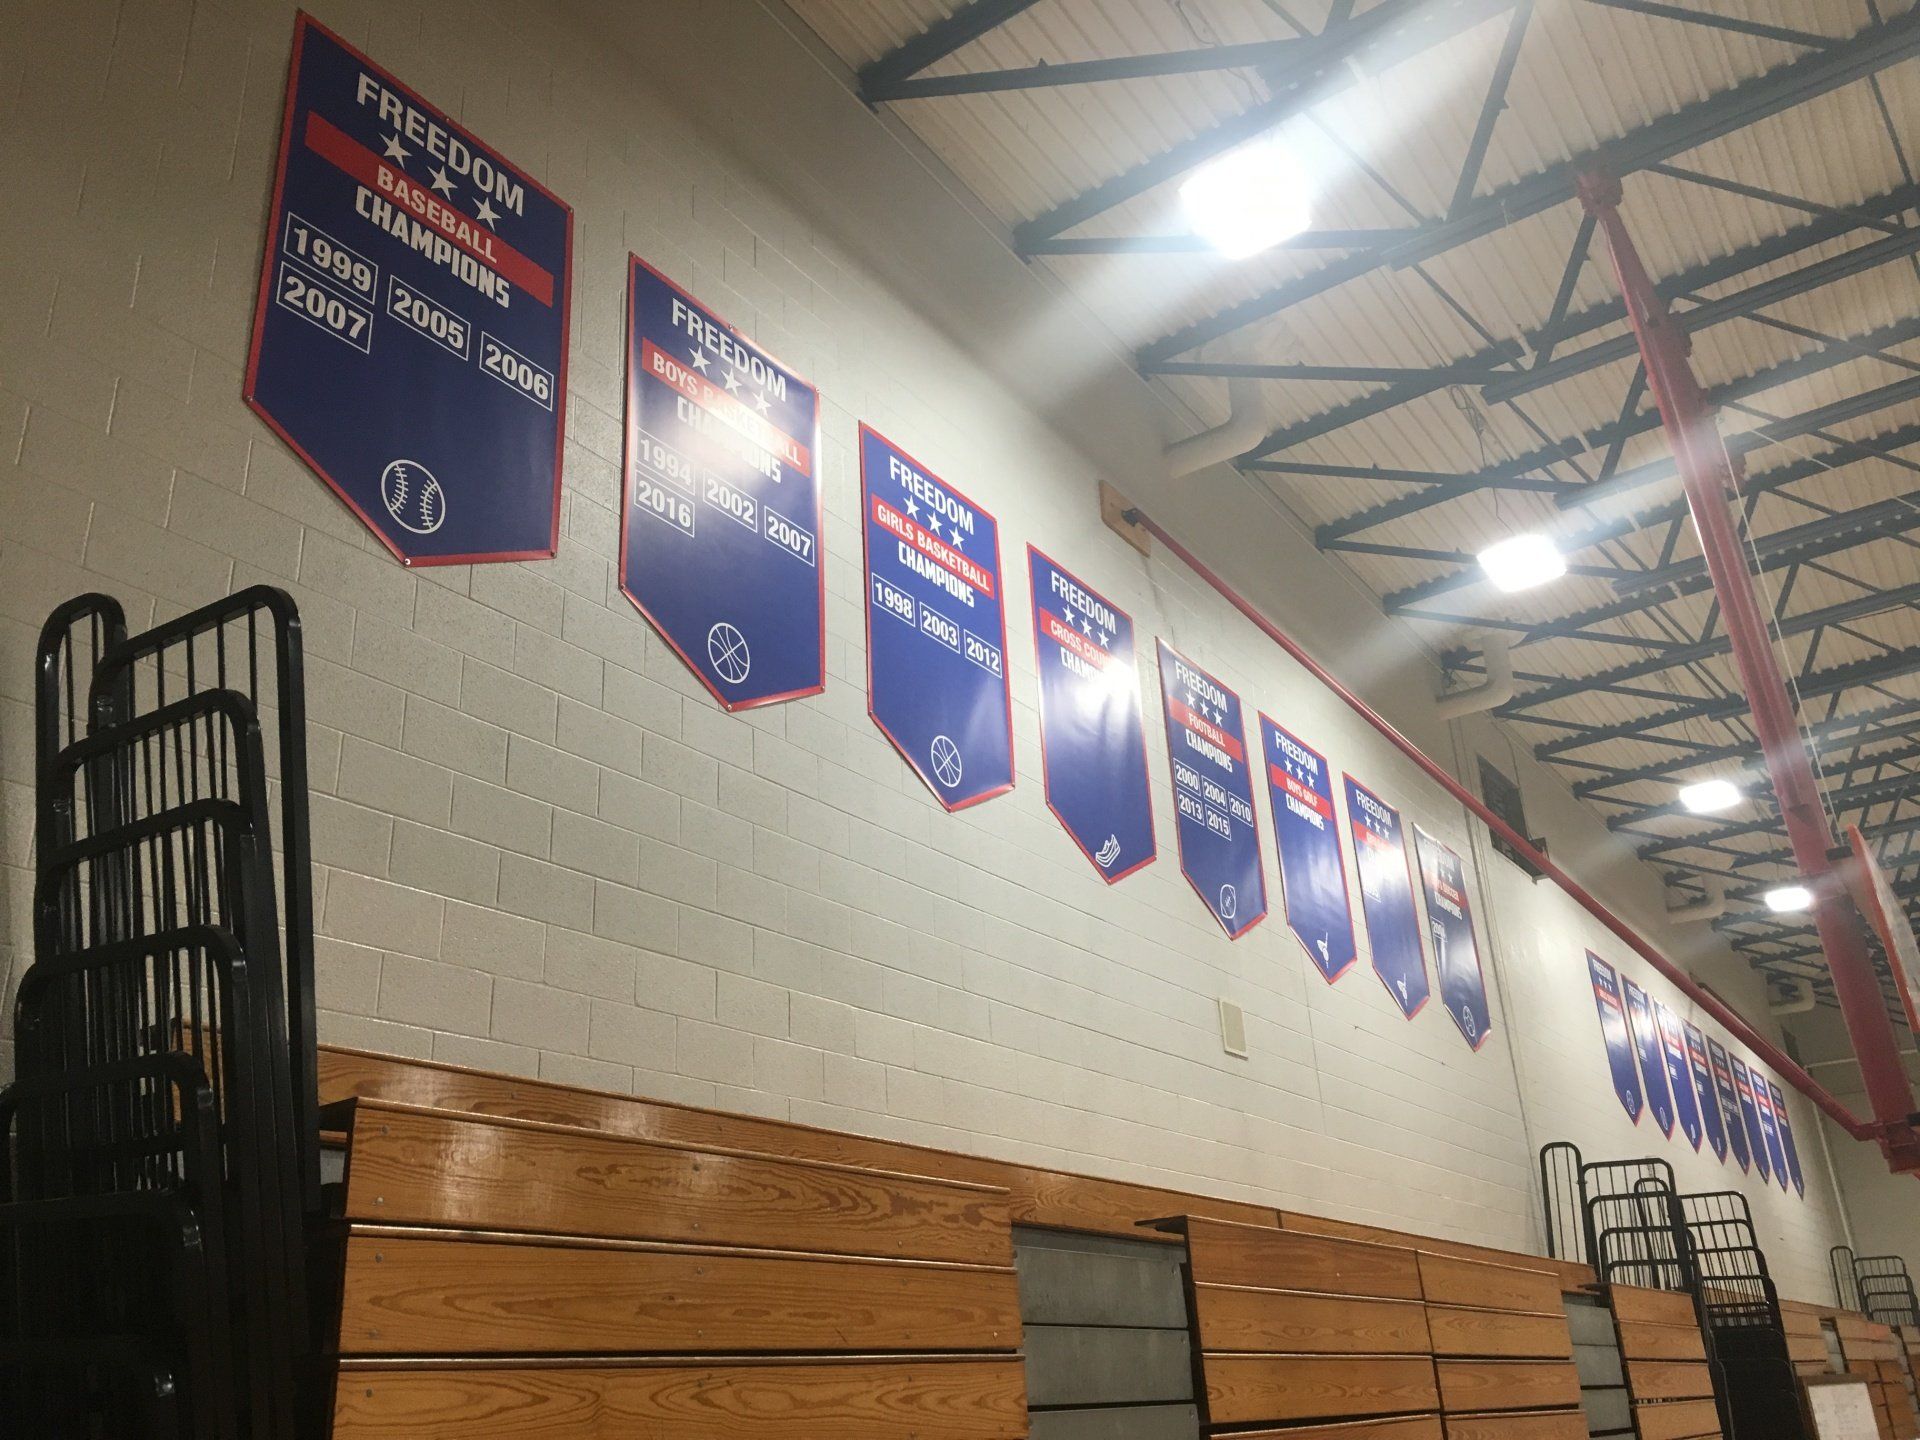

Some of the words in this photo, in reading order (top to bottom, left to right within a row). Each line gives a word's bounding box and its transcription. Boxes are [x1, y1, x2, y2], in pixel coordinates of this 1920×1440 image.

[356, 71, 524, 217] FREEDOM
[377, 164, 497, 264] BASEBALL
[294, 227, 372, 292] 1999
[355, 185, 510, 308] CHAMPIONS
[284, 275, 367, 339] 2007
[393, 287, 465, 350] 2005
[485, 343, 549, 401] 2006
[672, 297, 786, 402] FREEDOM
[653, 351, 698, 397] BOYS
[703, 386, 801, 466] BASKETALL
[640, 437, 692, 487] 1994
[638, 480, 691, 529] 2016
[706, 478, 754, 525] 2002
[889, 455, 974, 536] FREEDOM
[767, 515, 811, 557] 2007
[877, 504, 914, 541] GIRLS
[917, 528, 990, 591] BASKETBALL
[898, 540, 975, 608] CHAMPIONS
[875, 581, 913, 619] 1998
[1051, 570, 1117, 635] FREEDOM
[922, 610, 958, 647] 2003
[1050, 620, 1082, 649] CROSS
[966, 637, 1000, 672] 2012
[1175, 660, 1228, 713] FREEDOM
[1185, 728, 1233, 773] CHAMPIONS
[1188, 712, 1226, 747] FOOTBALL
[1274, 730, 1319, 776] FREEDOM
[1176, 764, 1199, 791] 2000
[1203, 781, 1226, 807] 2004
[1179, 794, 1203, 821] 2013
[1207, 810, 1230, 835] 2015
[1230, 797, 1251, 822] 2010
[1285, 792, 1325, 831] CHAMPIONS
[1355, 788, 1392, 828] FREEDOM
